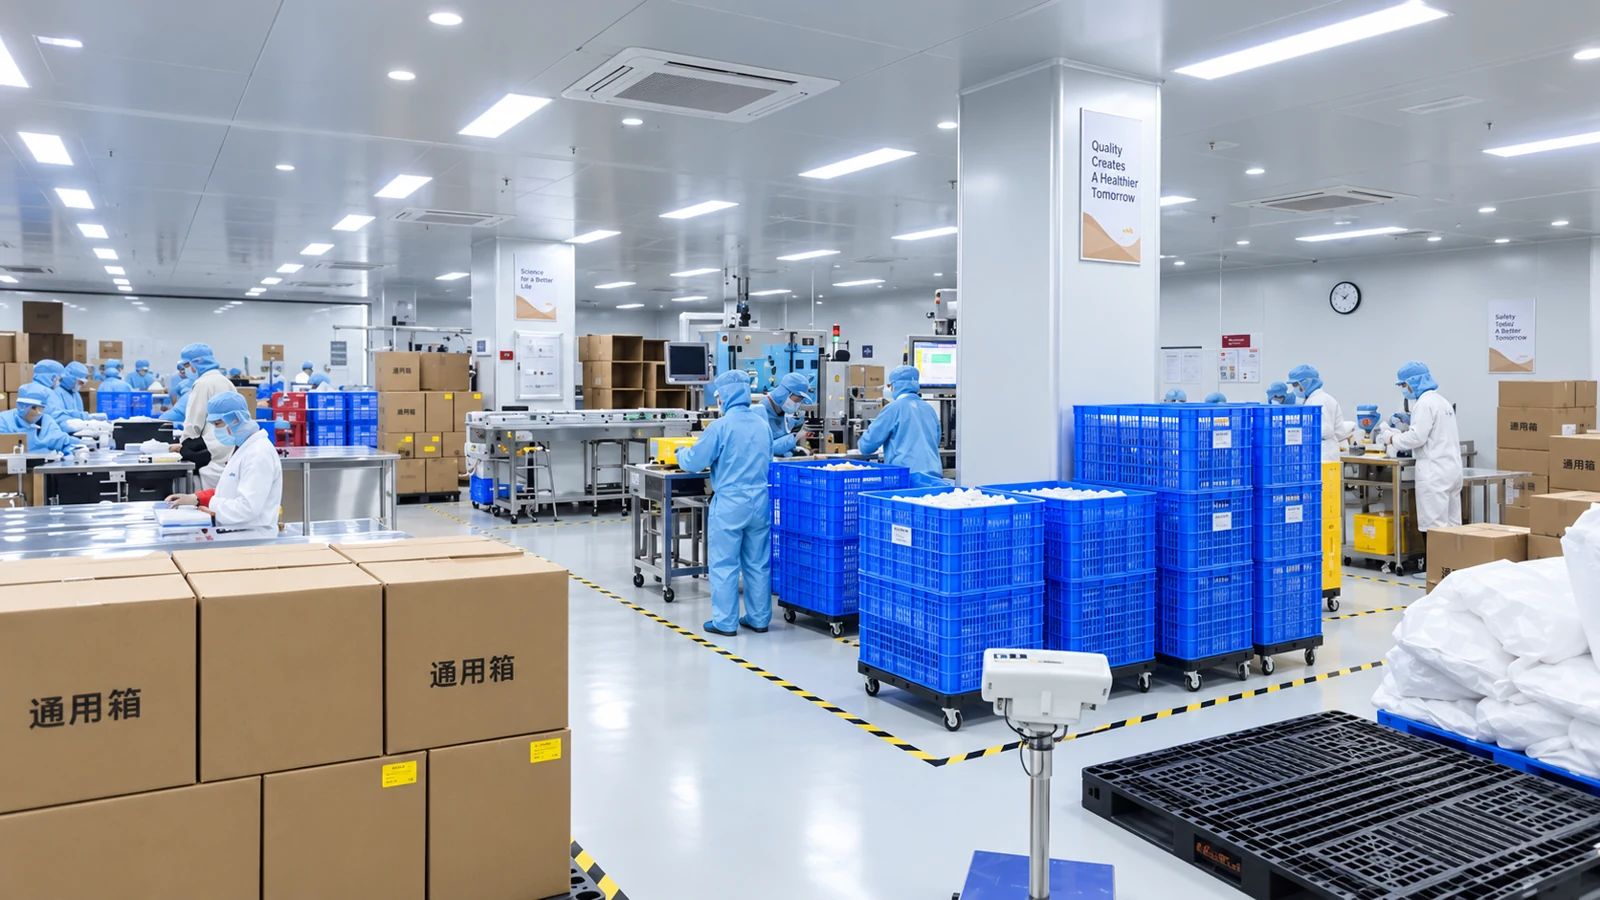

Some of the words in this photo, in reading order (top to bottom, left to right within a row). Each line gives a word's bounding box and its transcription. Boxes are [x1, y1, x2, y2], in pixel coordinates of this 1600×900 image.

[1091, 139, 1123, 158] Quality
[1091, 155, 1126, 172] Creates
[1091, 172, 1099, 183] A
[1100, 173, 1139, 188] Healthier
[1091, 187, 1136, 203] Tomorrow
[520, 268, 544, 276] Science
[1495, 313, 1516, 321] Safety
[1510, 421, 1538, 432] 通用箱
[1562, 458, 1596, 471] 通用箱
[429, 654, 515, 688] 通用箱
[29, 687, 142, 730] 通用箱
